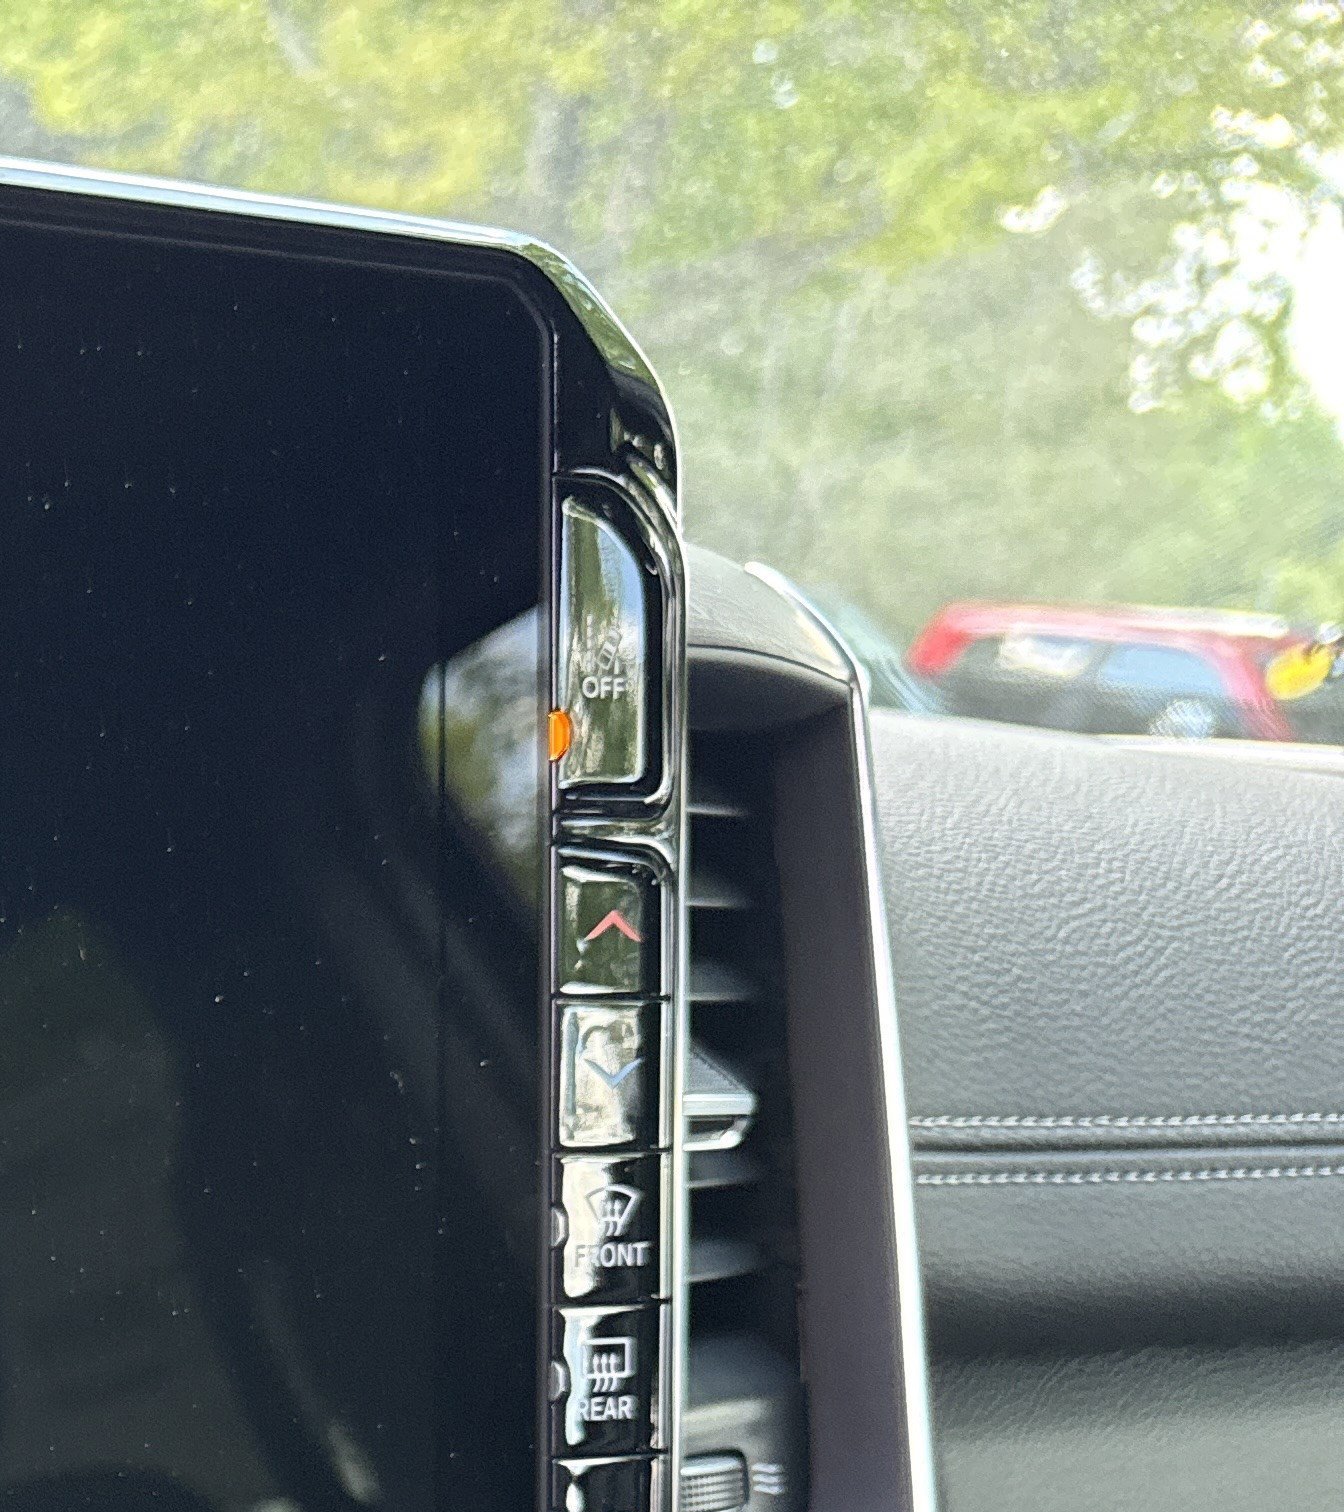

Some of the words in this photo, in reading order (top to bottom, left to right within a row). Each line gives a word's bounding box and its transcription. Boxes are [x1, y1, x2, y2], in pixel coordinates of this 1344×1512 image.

[581, 675, 628, 700] OFF
[573, 1241, 651, 1268] FRONT
[577, 1395, 637, 1422] REAR
